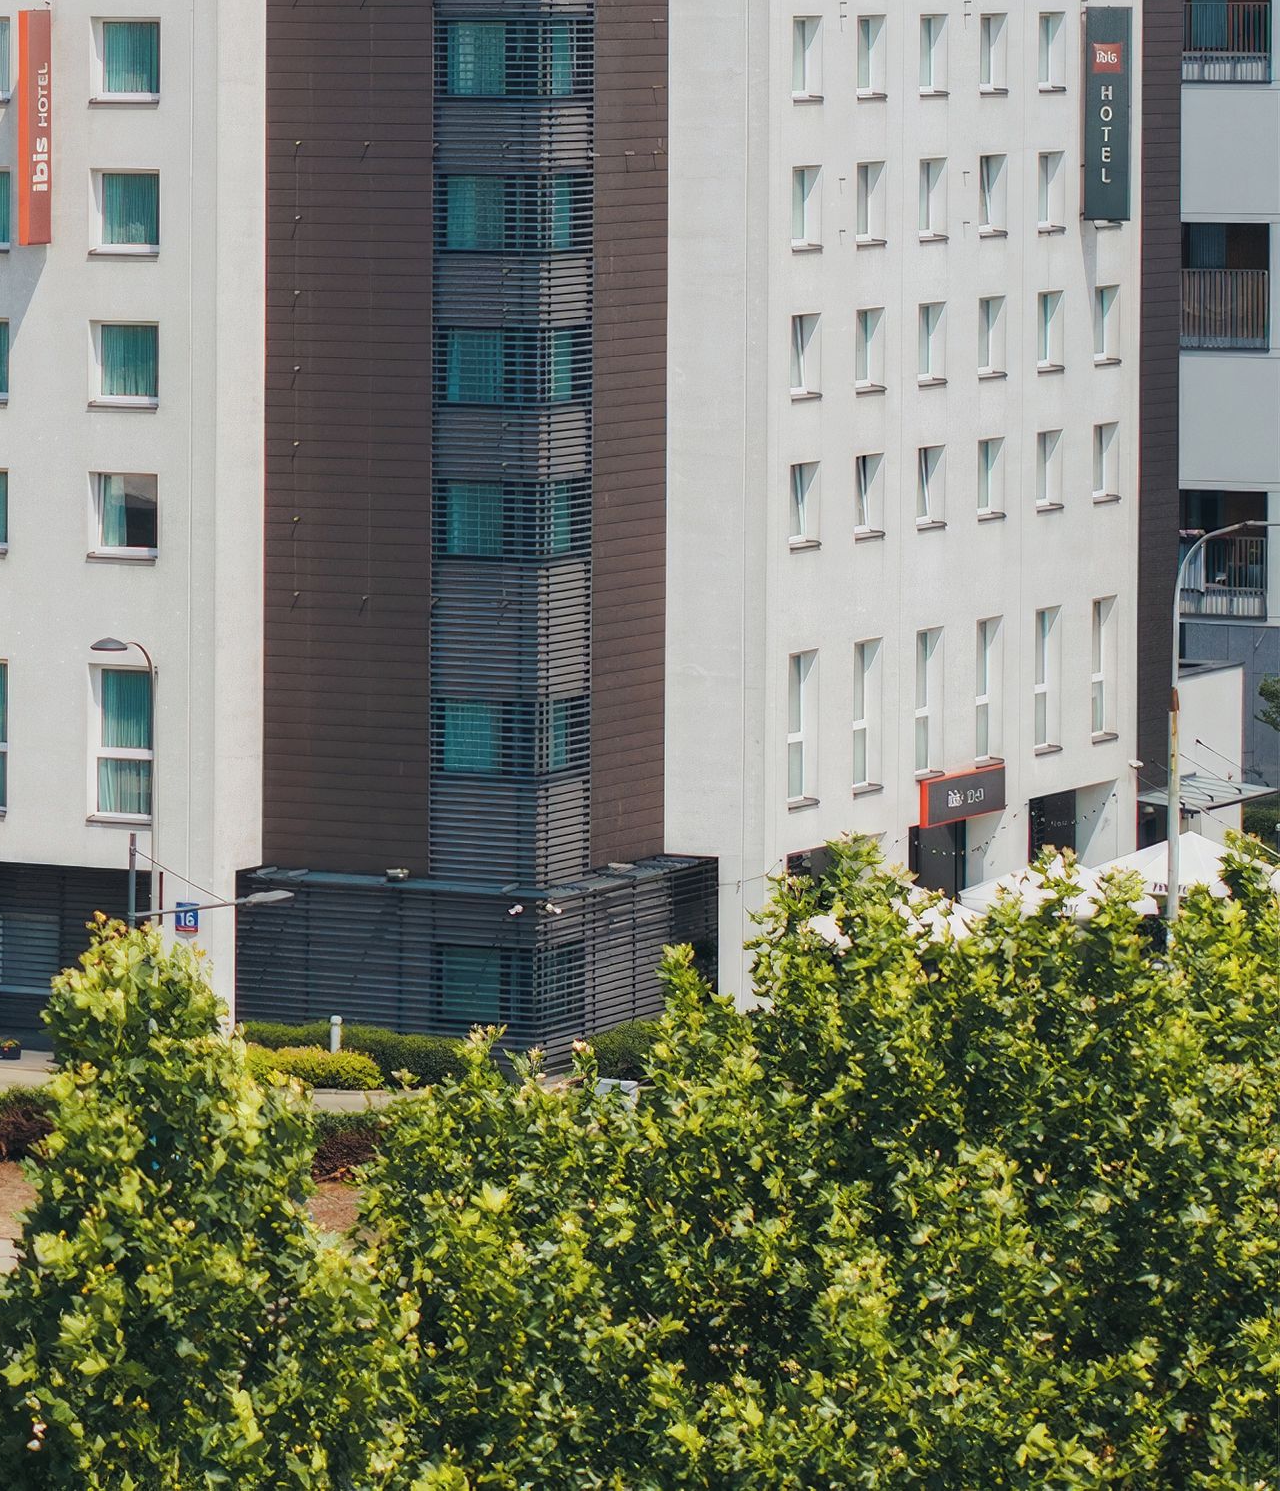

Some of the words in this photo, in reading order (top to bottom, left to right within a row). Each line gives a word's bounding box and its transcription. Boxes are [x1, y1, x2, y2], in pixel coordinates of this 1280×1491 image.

[37, 62, 49, 127] HOTEL
[1100, 85, 1113, 183] HOTEL
[32, 137, 48, 192] ibis
[180, 912, 196, 927] 16
